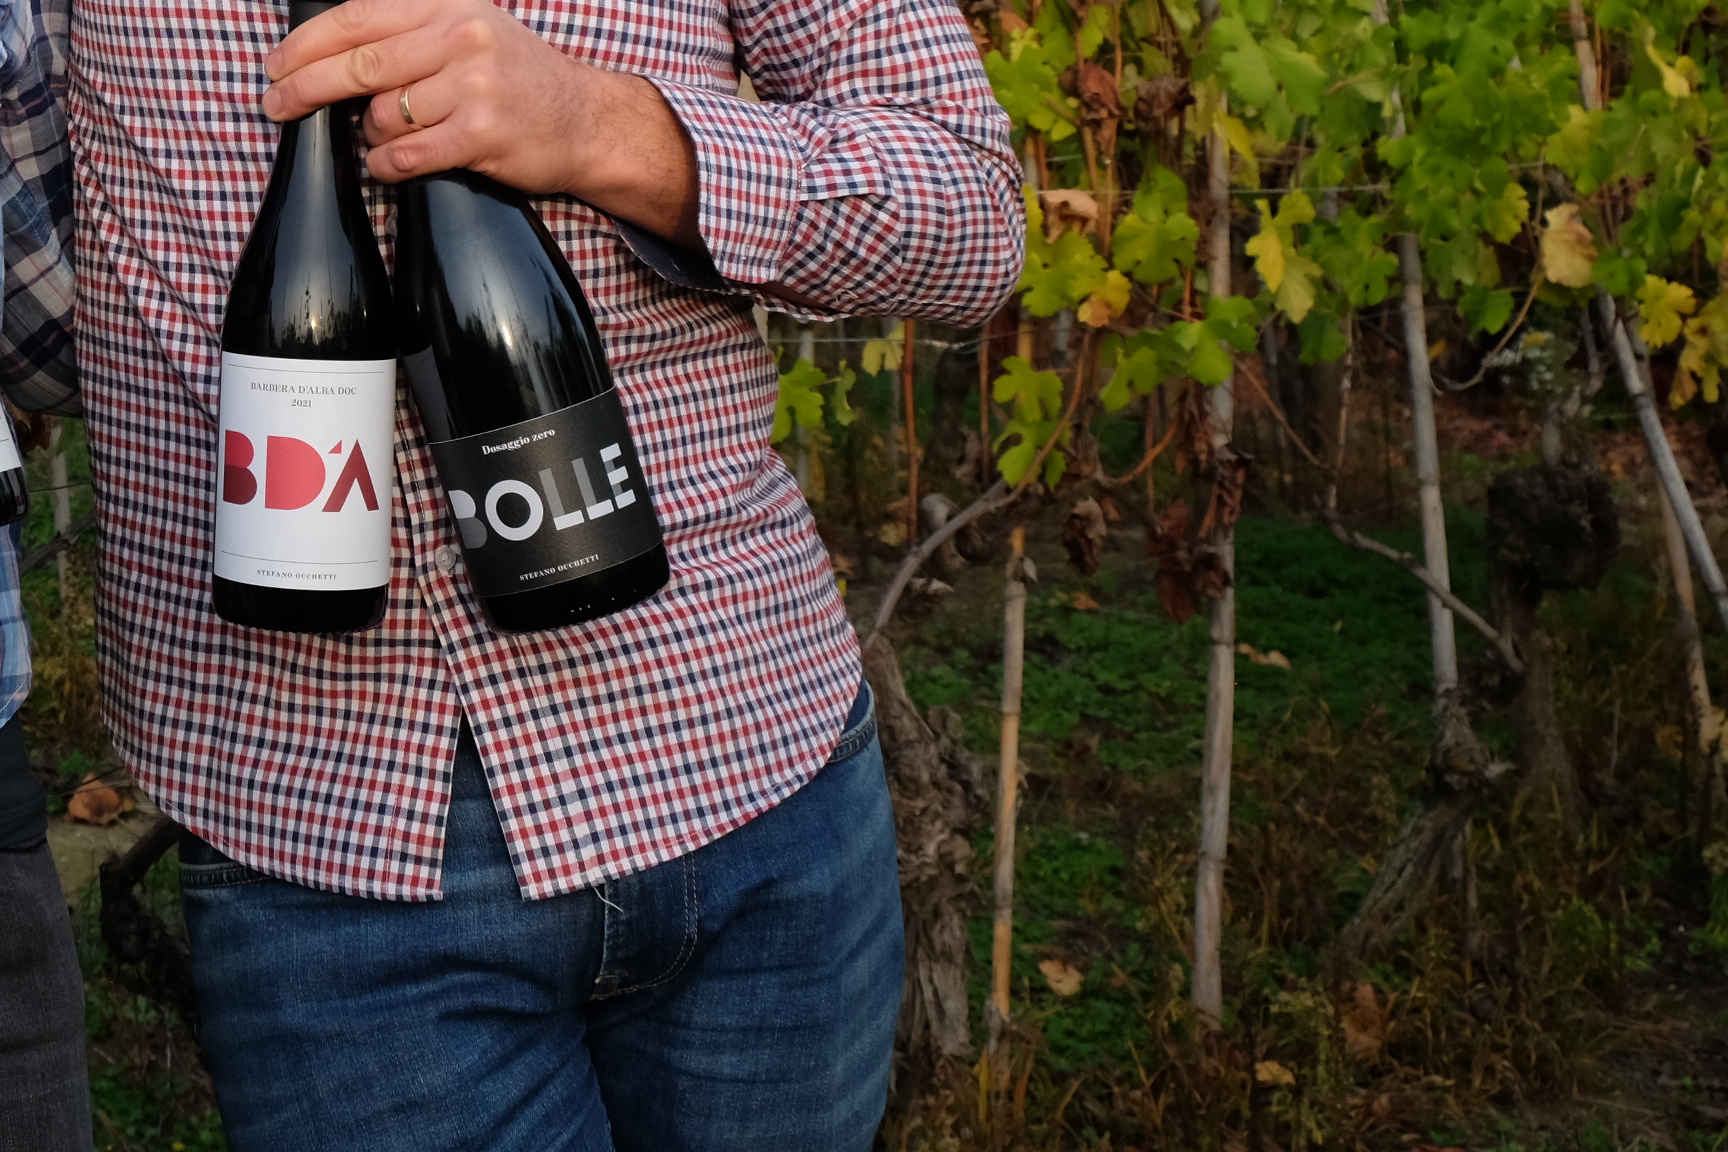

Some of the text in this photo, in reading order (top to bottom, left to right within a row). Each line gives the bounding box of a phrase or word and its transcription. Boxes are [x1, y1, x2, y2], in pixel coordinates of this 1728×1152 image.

[250, 382, 357, 395] BARBERA D'ALBA DOC
[291, 399, 312, 407] 2021
[481, 429, 556, 455] Dosaggio zero
[448, 442, 637, 550] BOLLE
[257, 569, 336, 580] STEFANO OCCHETTI
[519, 553, 600, 581] STEFANO OCCHETTI
